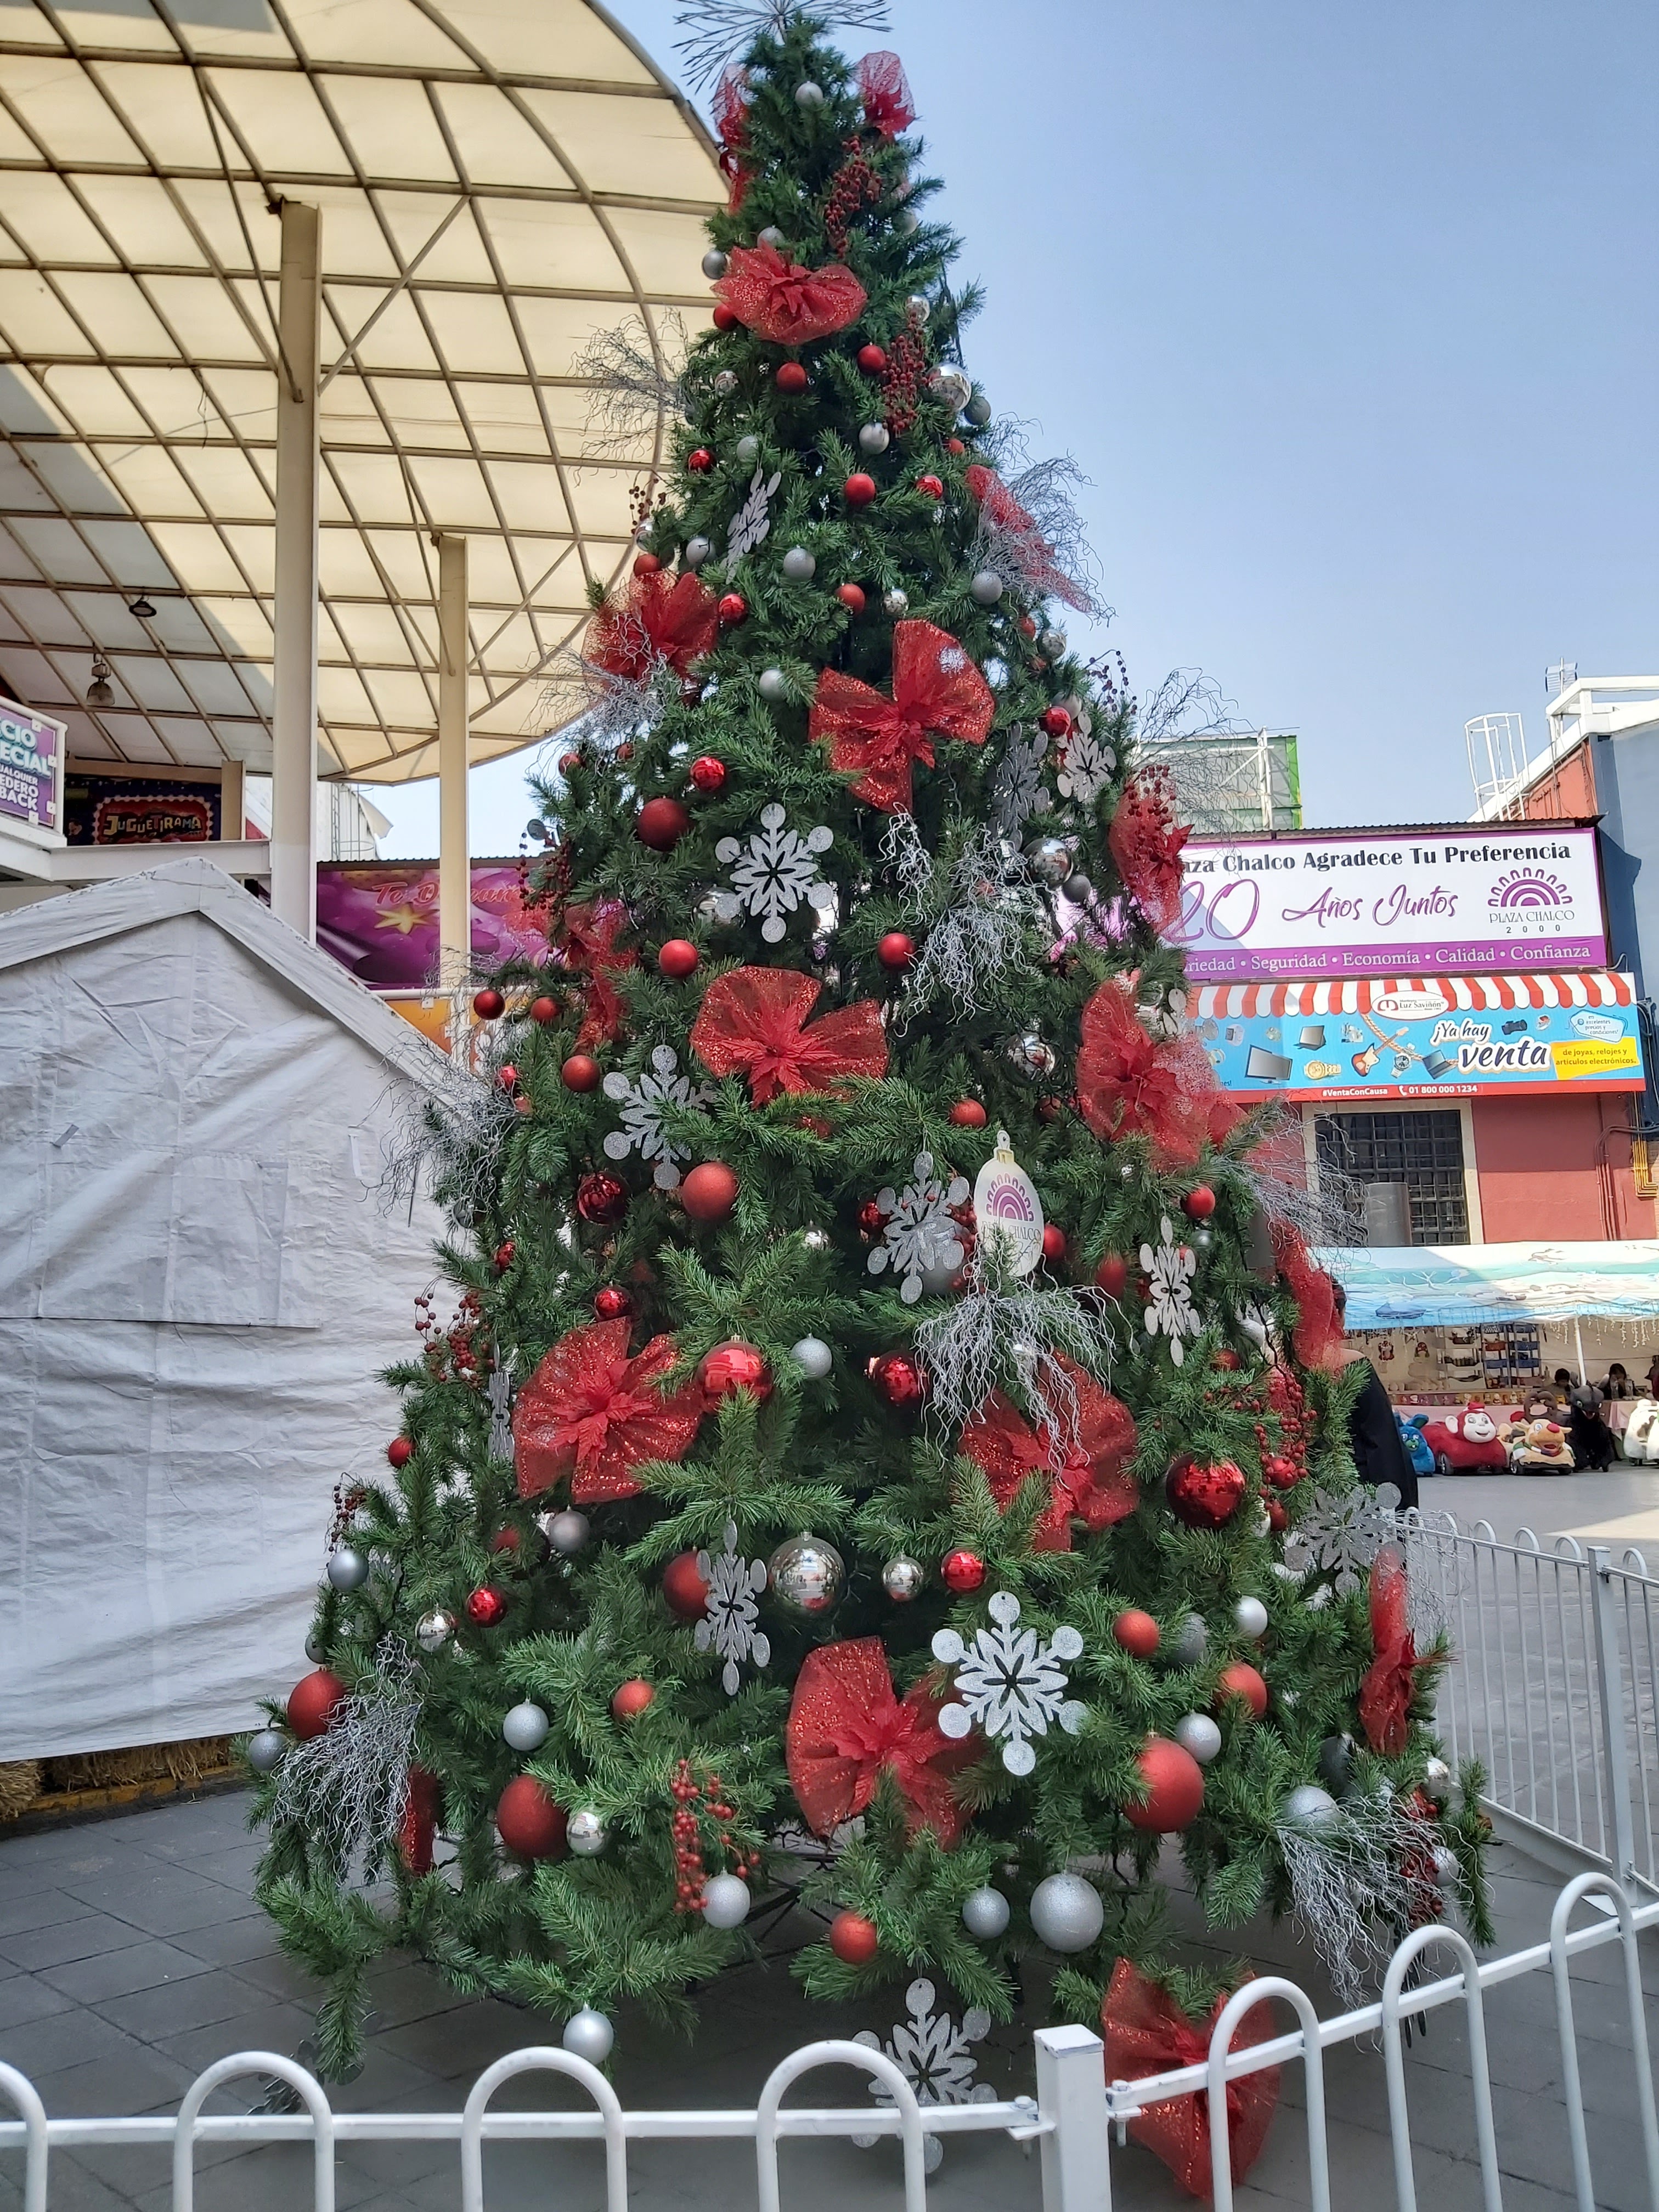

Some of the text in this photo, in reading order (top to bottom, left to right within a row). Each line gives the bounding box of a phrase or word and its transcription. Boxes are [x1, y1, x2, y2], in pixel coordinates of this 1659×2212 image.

[0, 718, 36, 749] CIO
[1223, 854, 1295, 872] Chalco
[1304, 850, 1402, 872] Agradece
[1409, 848, 1437, 865] Tu
[1444, 843, 1571, 863] Preferencia
[372, 882, 408, 905] Te
[1162, 879, 1458, 942] 20 Años Juntos
[1489, 910, 1575, 924] PLAZA CHALCO
[1184, 944, 1591, 973] riedad Seguridad Economía Calidad Confianza
[1462, 1020, 1489, 1042] hay
[1462, 1040, 1547, 1068] venta
[1596, 1048, 1622, 1056] relojes
[1322, 1088, 1388, 1097] #VentaConCausa
[1408, 1085, 1478, 1094] 01 800 000 1234
